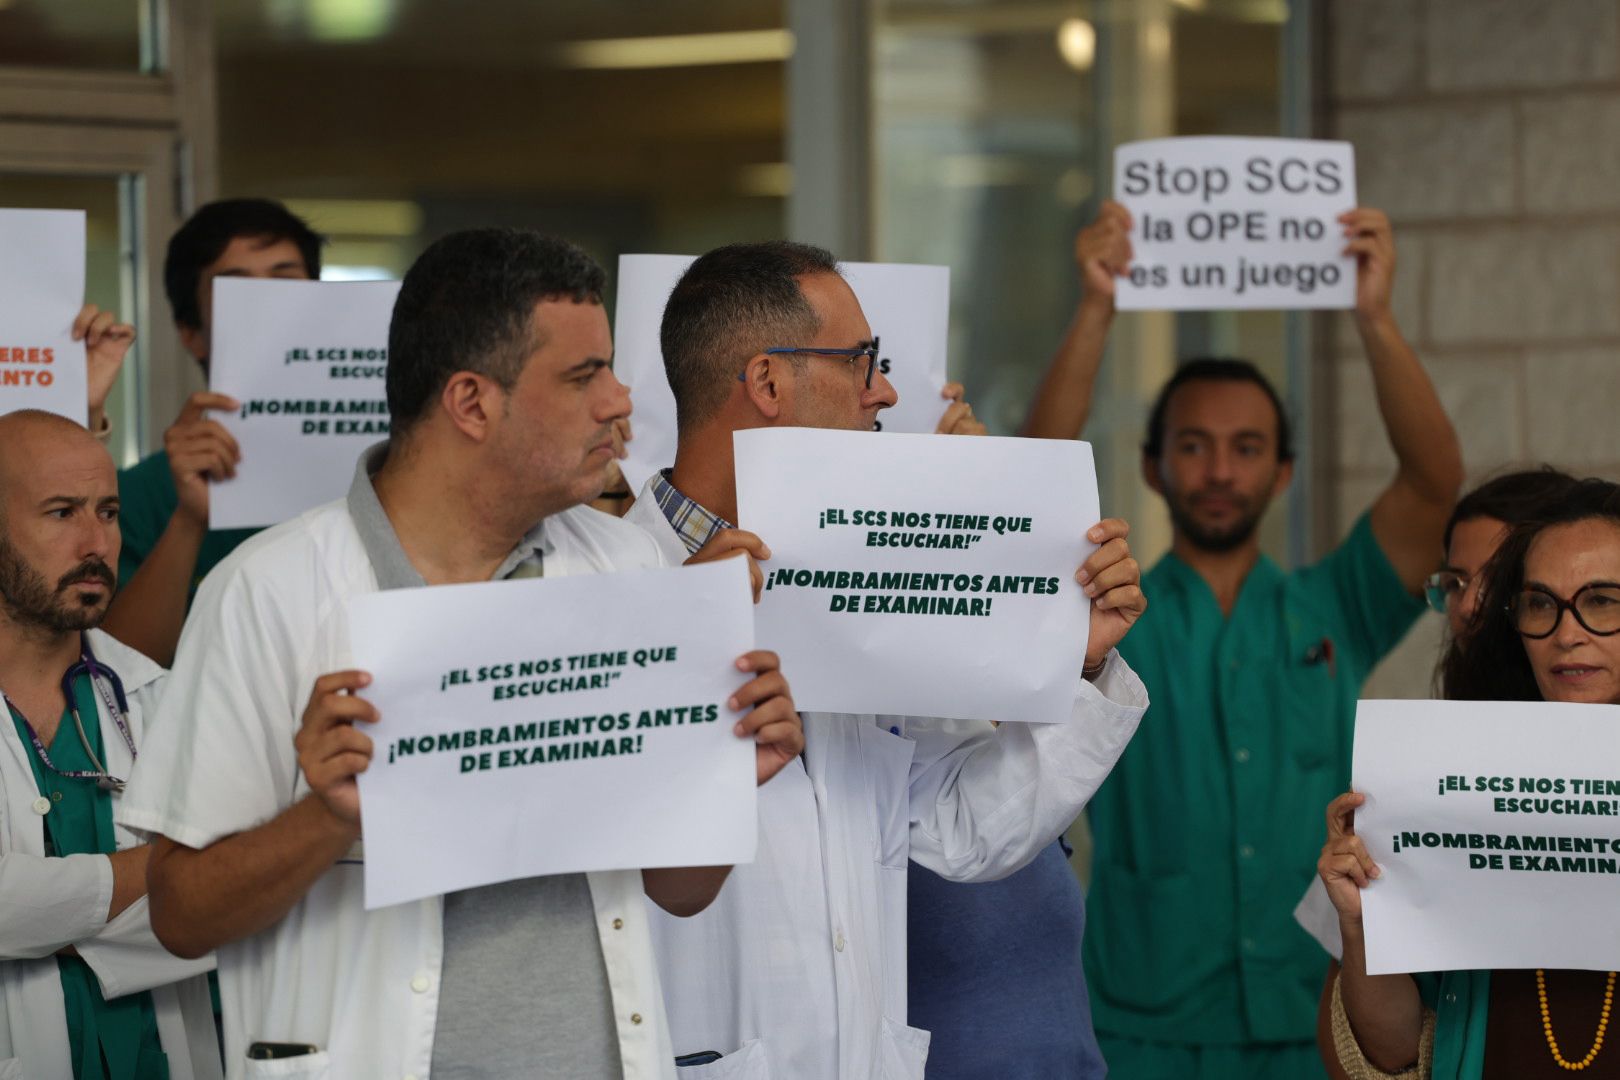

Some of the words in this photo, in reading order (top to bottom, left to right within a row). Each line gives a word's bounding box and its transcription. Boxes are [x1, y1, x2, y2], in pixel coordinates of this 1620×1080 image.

[1123, 159, 1230, 203] Stop
[1246, 157, 1342, 194] SCS
[1143, 213, 1173, 242] la
[1186, 212, 1267, 242] OPE
[1280, 218, 1325, 241] no
[1129, 263, 1168, 288] es
[1181, 264, 1225, 287] un
[1235, 258, 1341, 294] juego
[316, 348, 347, 361] SCS
[0, 369, 54, 387] NTO
[302, 420, 329, 434] DE
[819, 508, 848, 528] ¡EL
[852, 509, 887, 527] SCS
[891, 511, 932, 529] NOS
[934, 513, 990, 531] TIENE
[993, 515, 1032, 536] QUE
[767, 569, 985, 593] ¡NOMBRAMIENTOS
[986, 575, 1060, 595] ANTES
[829, 594, 860, 613] DE
[863, 595, 992, 616] EXAMINAR!
[441, 669, 472, 692] ¡EL
[476, 663, 513, 683] SCS
[518, 657, 562, 677] NOS
[567, 650, 628, 672] TIENE
[632, 646, 677, 668] QUE
[388, 712, 631, 764] ¡NOMBRAMIENTOS
[636, 704, 719, 729] ANTES
[460, 752, 492, 774] DE
[498, 734, 643, 769] EXAMINAR!
[1438, 775, 1471, 796] ¡EL
[1474, 777, 1515, 793] SCS
[1519, 778, 1566, 795] NOS
[1570, 779, 1620, 796] TIEN
[1493, 797, 1620, 816] ESCUCHAR!
[1468, 853, 1504, 870] DE
[1508, 854, 1620, 874] EXAMIN
